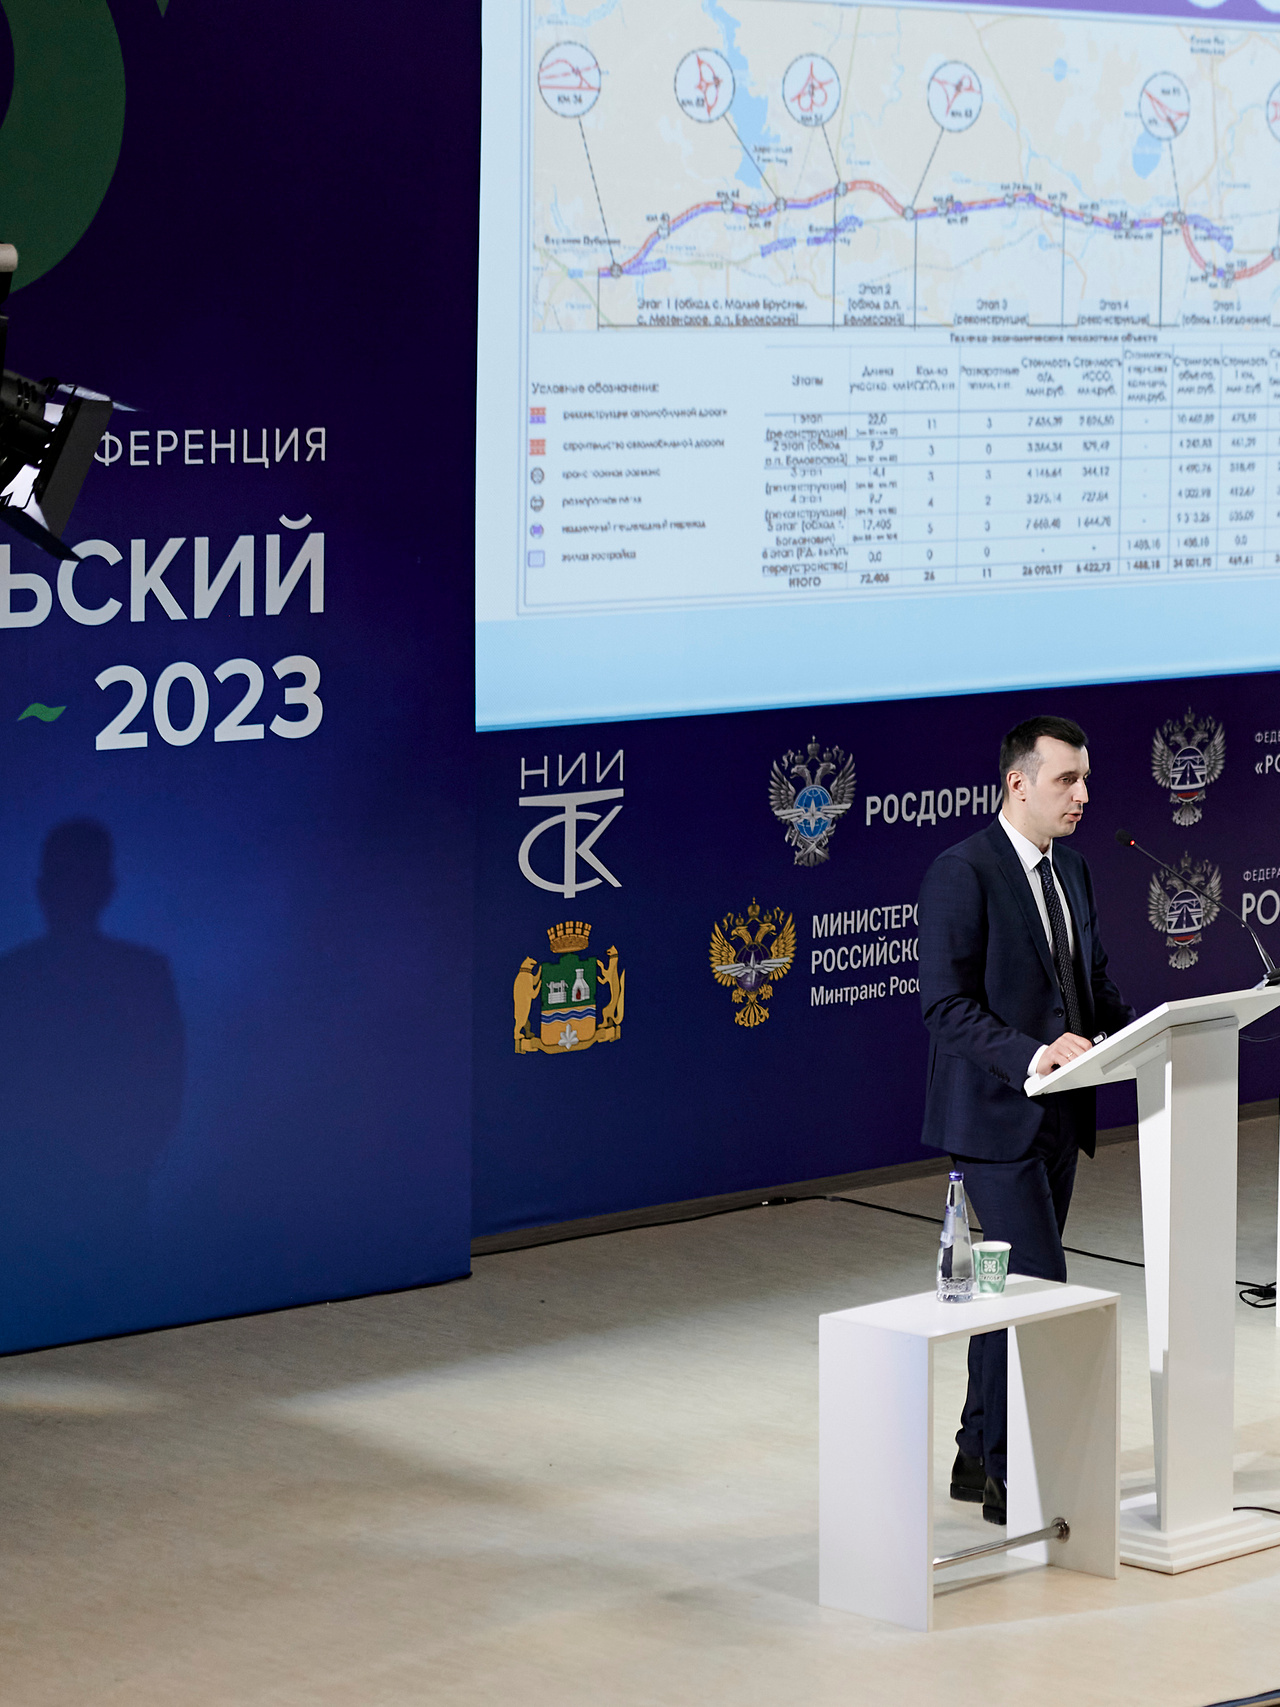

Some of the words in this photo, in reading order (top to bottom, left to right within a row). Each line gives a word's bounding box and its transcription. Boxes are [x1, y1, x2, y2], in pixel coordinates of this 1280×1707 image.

[95, 655, 323, 751] 2023
[520, 750, 624, 790] НИИ
[811, 982, 886, 1006] Минтранс
